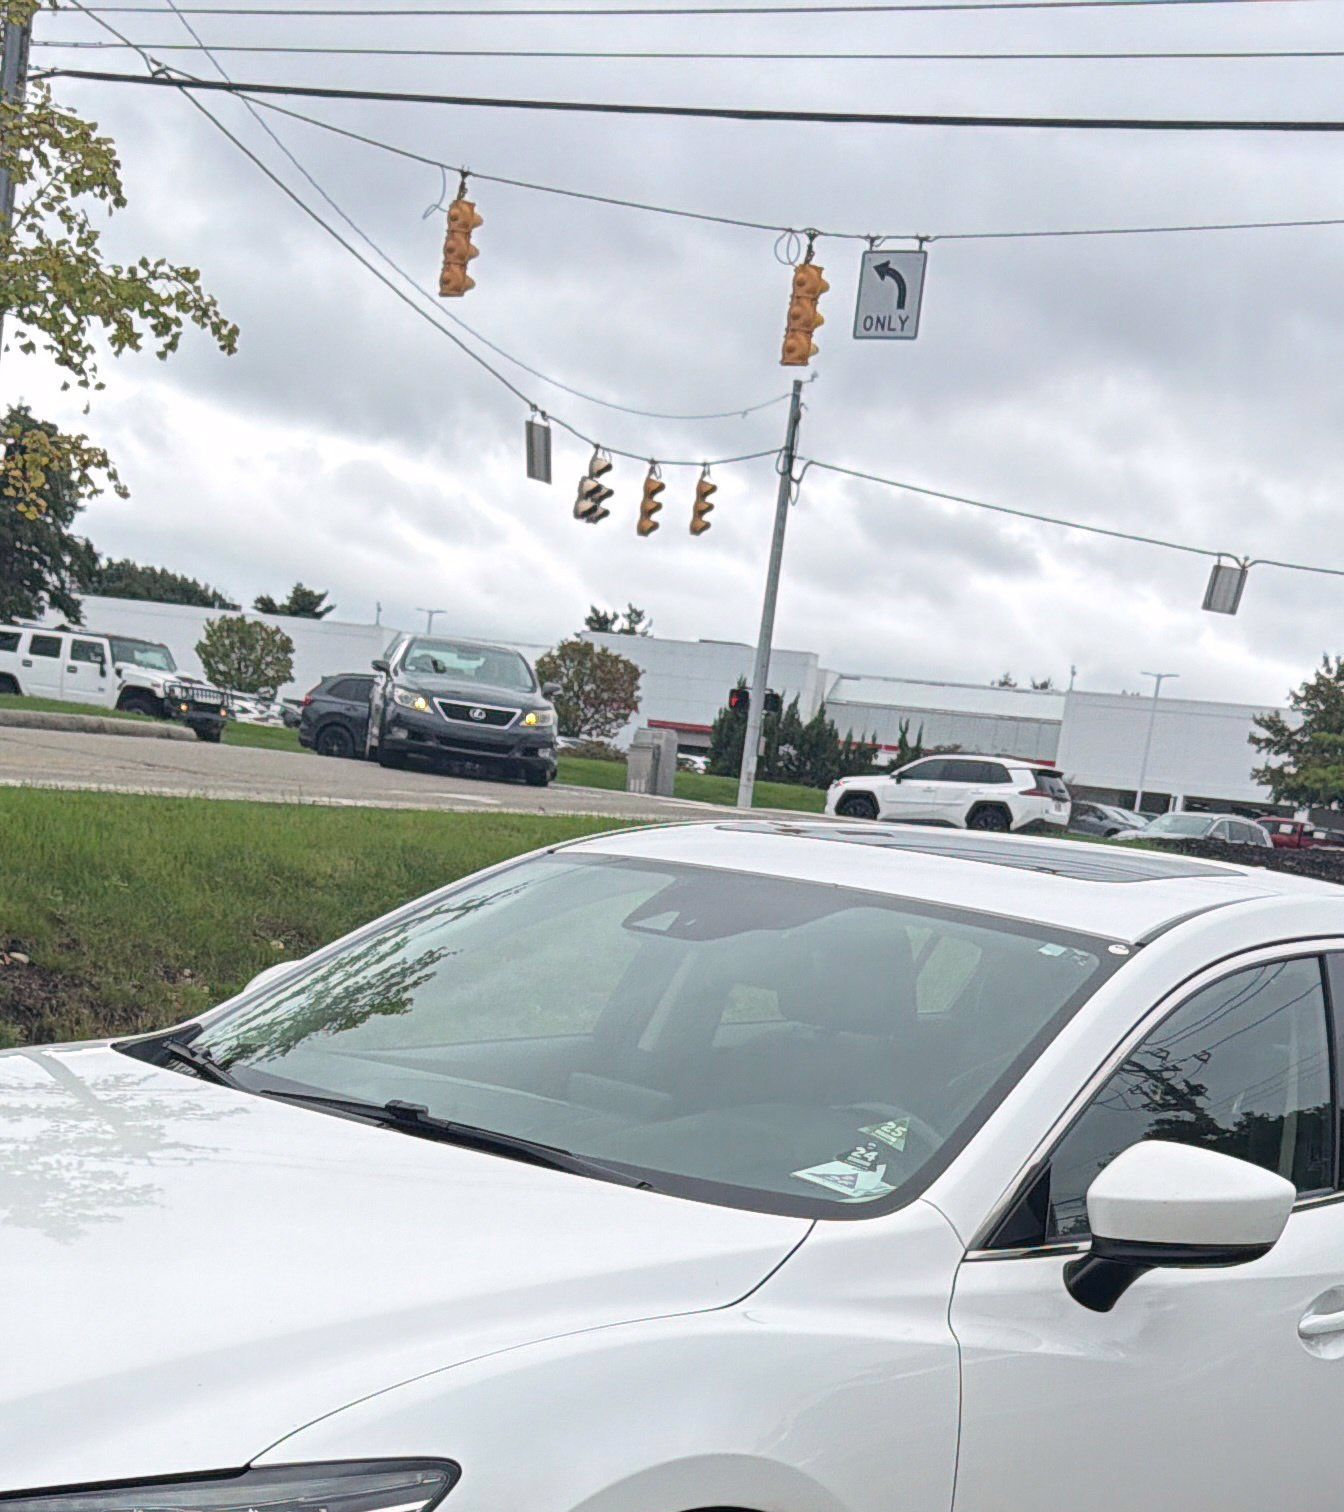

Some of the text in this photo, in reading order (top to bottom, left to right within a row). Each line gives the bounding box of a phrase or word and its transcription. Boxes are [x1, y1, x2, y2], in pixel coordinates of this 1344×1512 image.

[863, 315, 910, 332] ONLY
[880, 1121, 908, 1137] 25
[850, 1146, 878, 1161] 24
